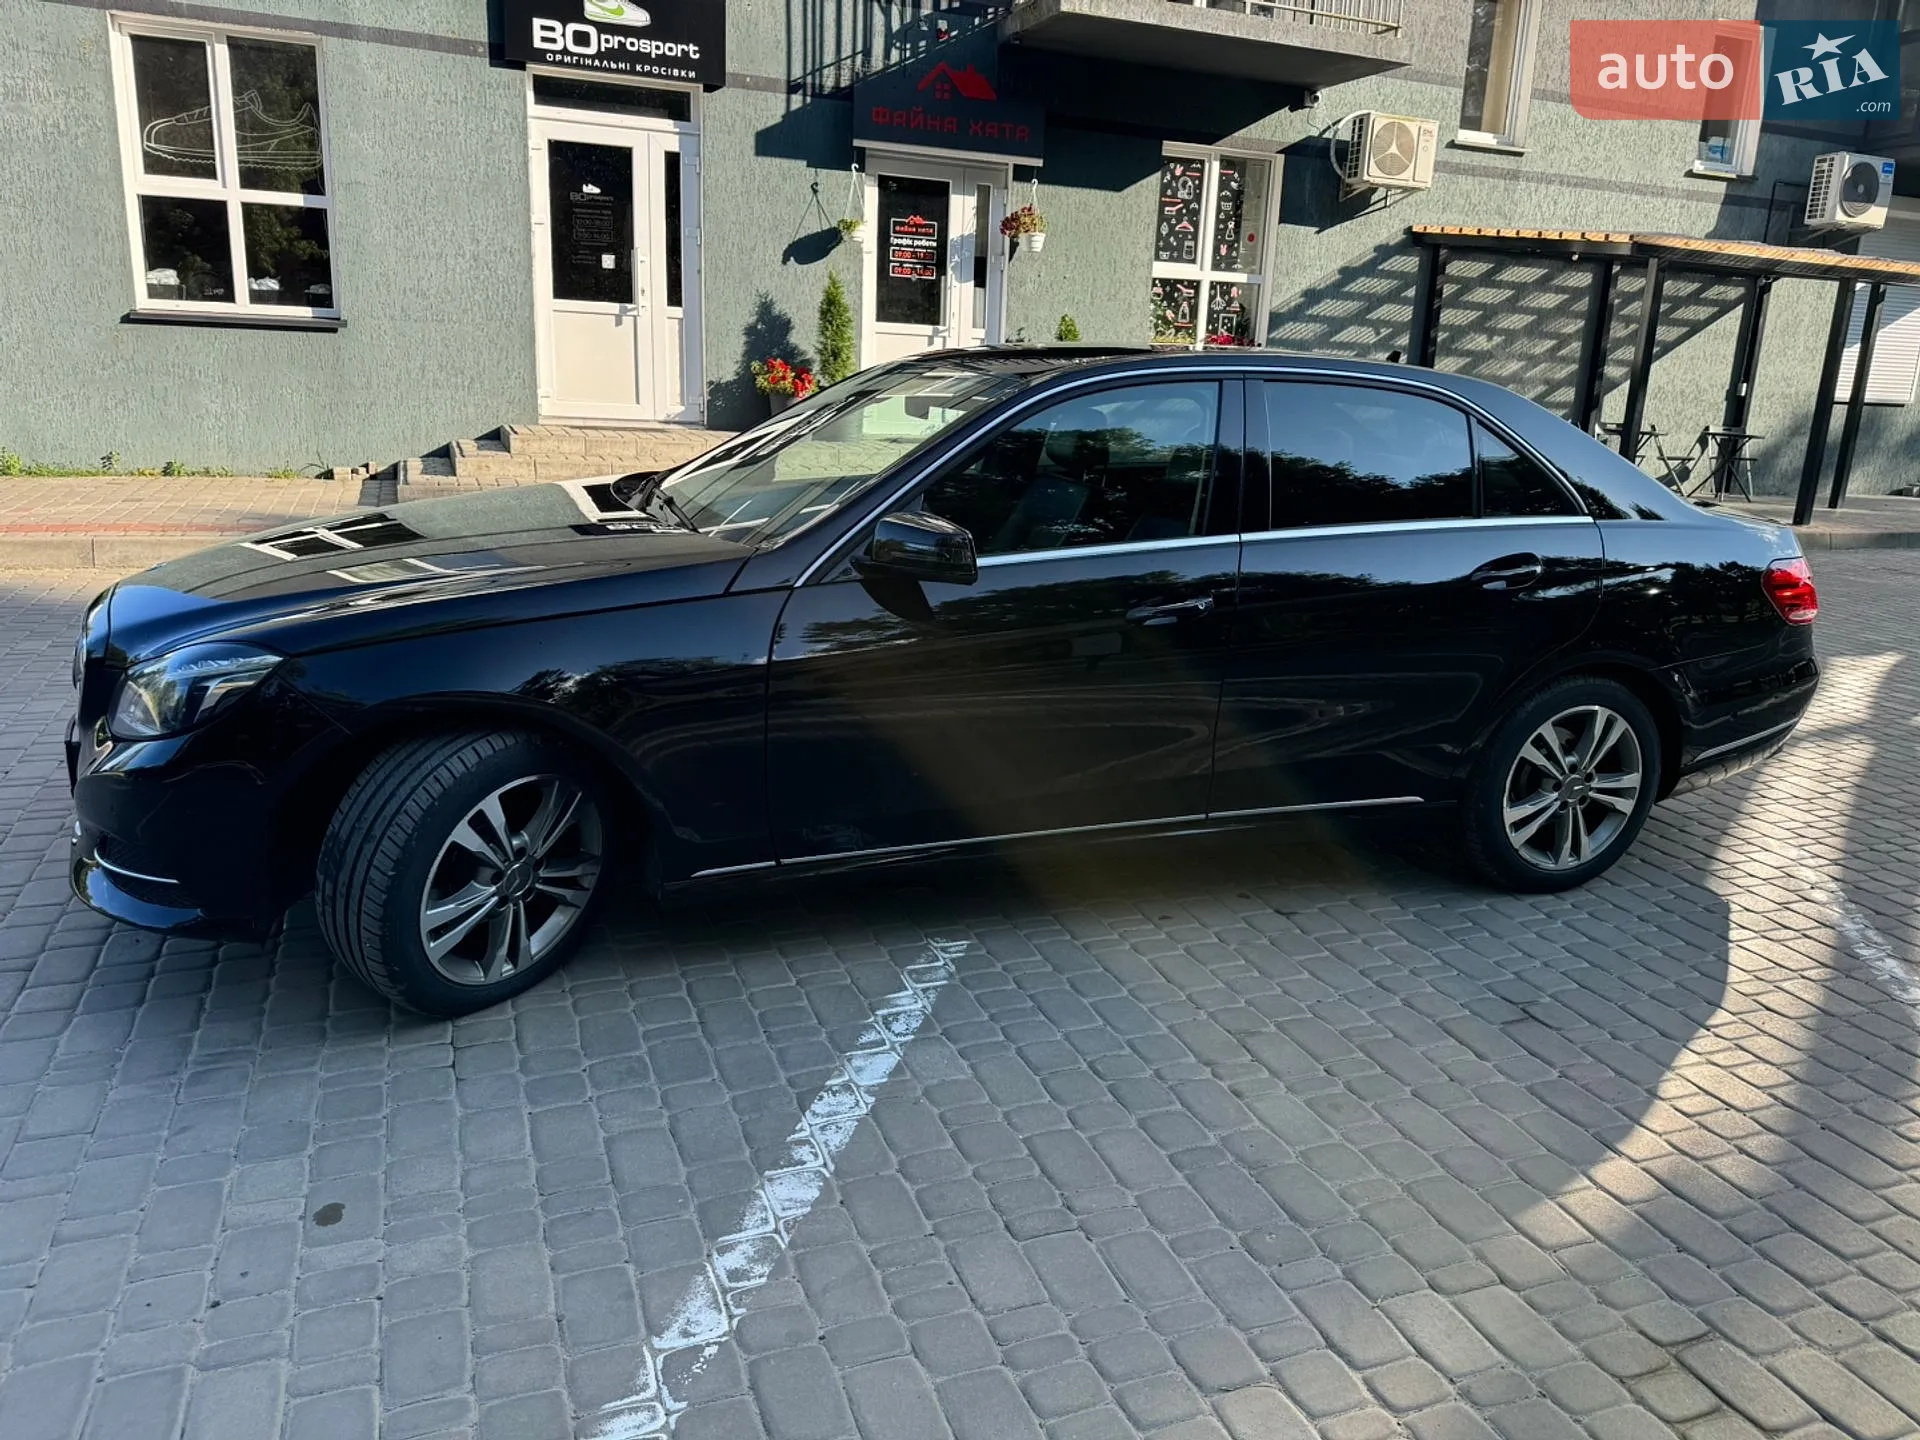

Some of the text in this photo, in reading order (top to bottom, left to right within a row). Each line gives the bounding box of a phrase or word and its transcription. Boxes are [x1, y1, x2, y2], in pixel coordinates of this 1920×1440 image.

[546, 53, 697, 79] ОРИГІНАЛЬНІ КРОСІВКИ
[872, 106, 1031, 143] ФАЙНА ХАТА
